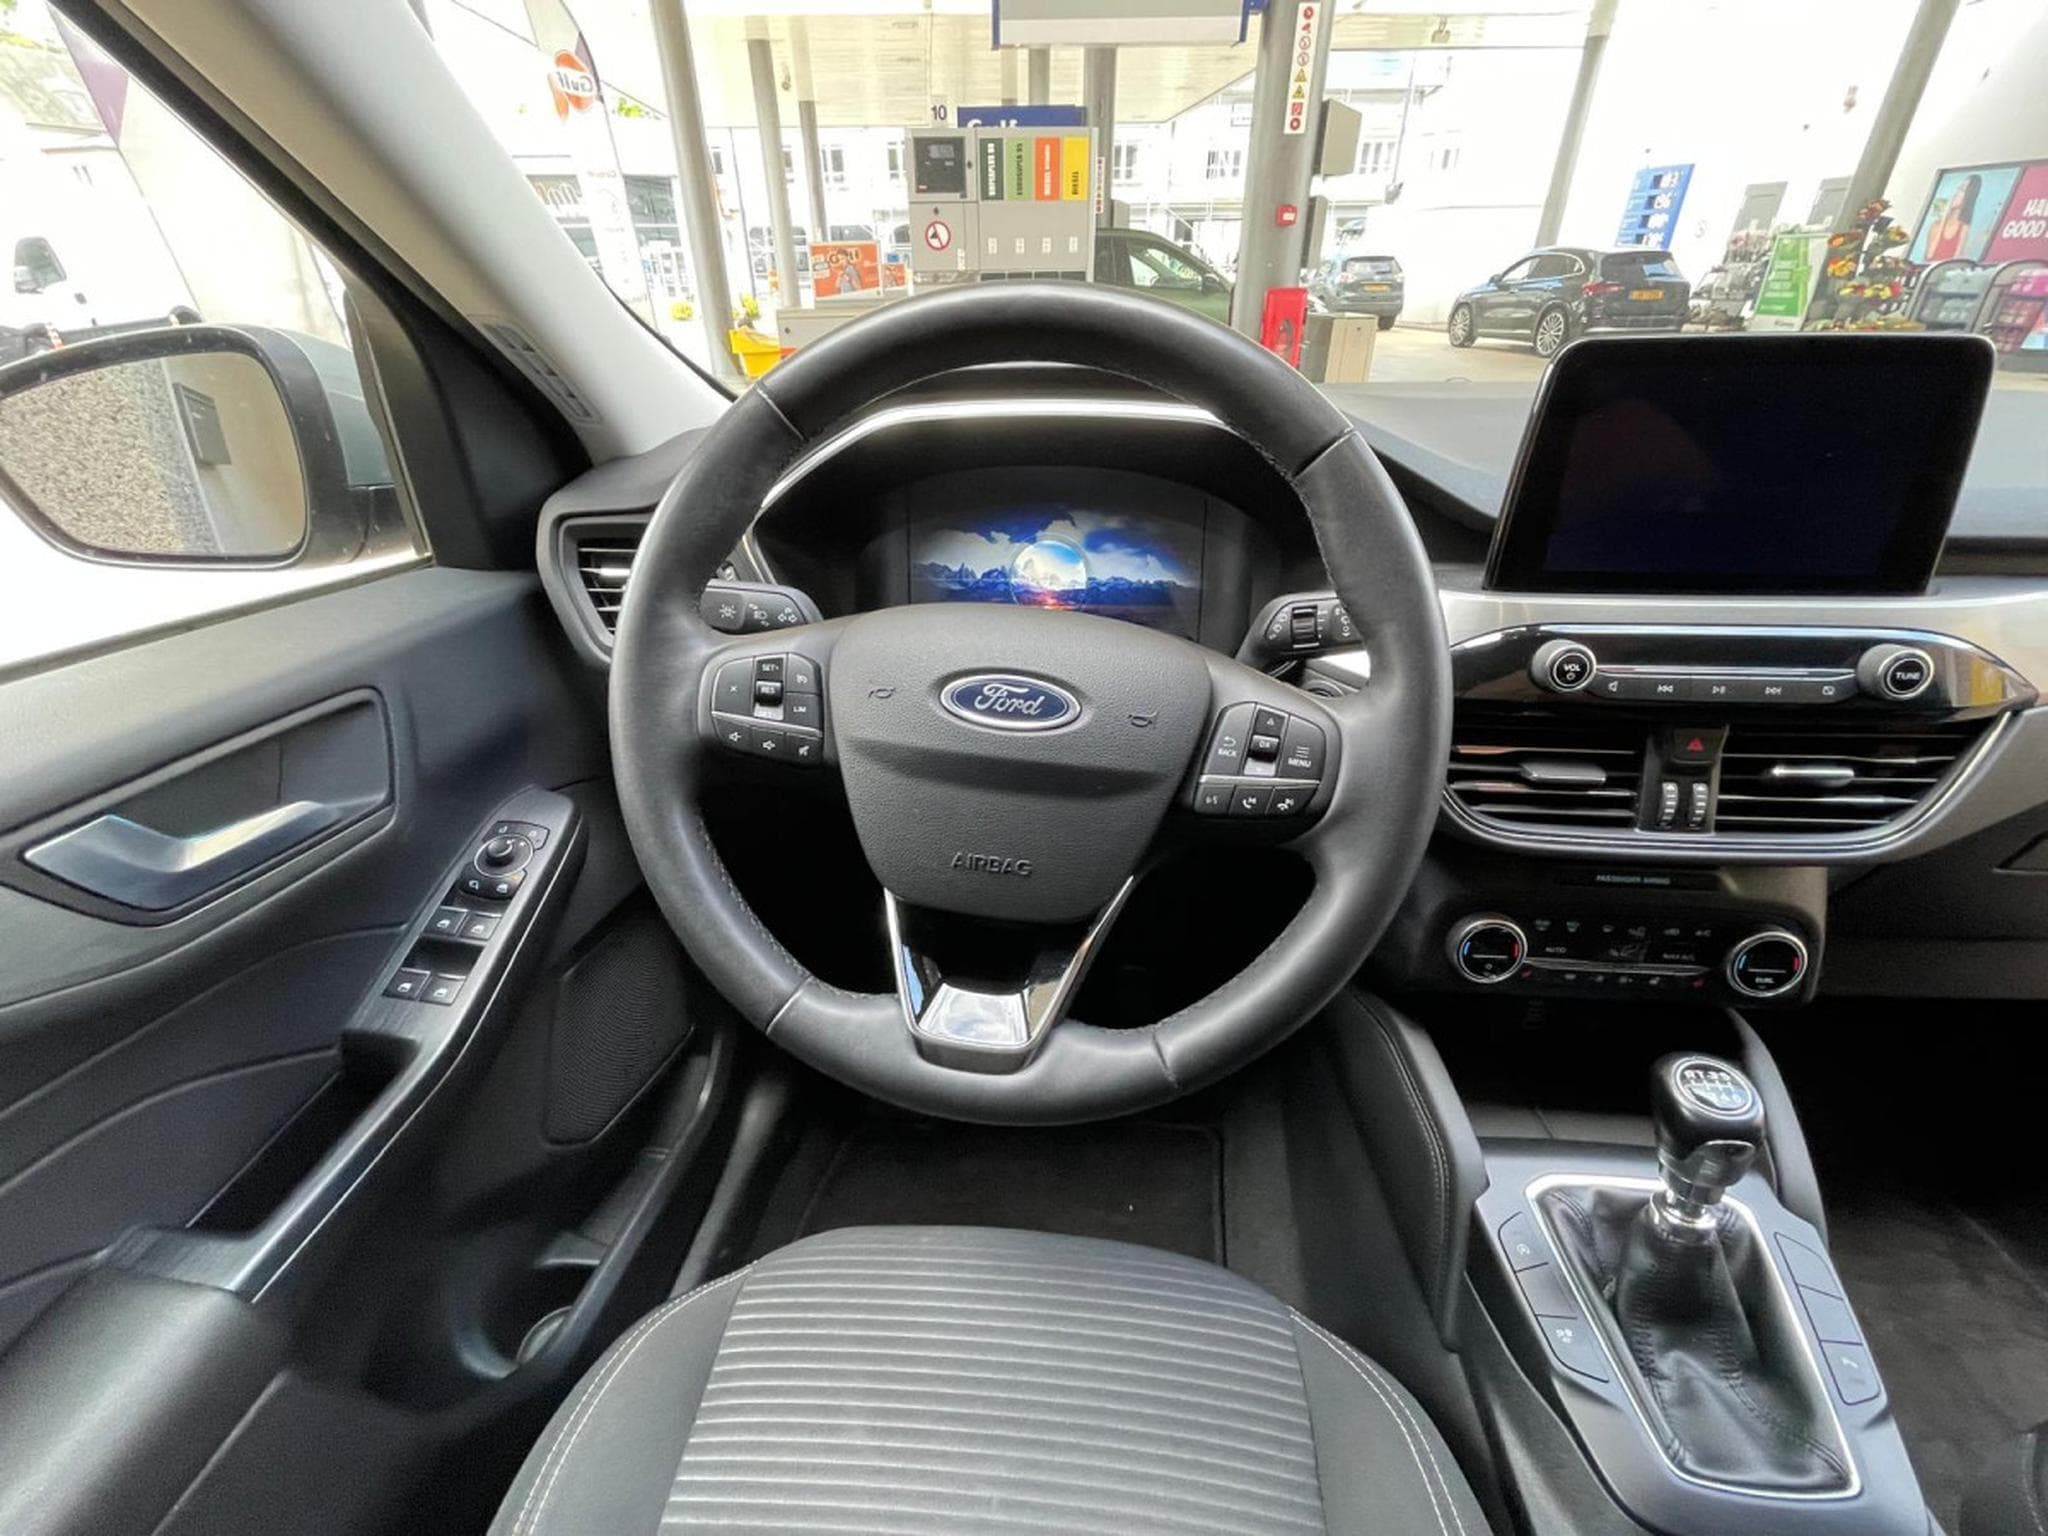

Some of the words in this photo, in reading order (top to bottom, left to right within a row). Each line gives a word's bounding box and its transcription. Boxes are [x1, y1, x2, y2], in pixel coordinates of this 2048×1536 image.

[931, 104, 947, 121] 10
[2002, 219, 2046, 239] GOOD
[1563, 663, 1581, 672] VOL
[1895, 671, 1921, 680] TUNE
[760, 686, 775, 694] RES
[973, 683, 1045, 716] Ford
[1258, 741, 1270, 749] OK
[1217, 748, 1238, 758] BACK
[1287, 757, 1312, 768] MENU
[950, 851, 1033, 876] AIRBAG
[1545, 946, 1567, 954] AUTO
